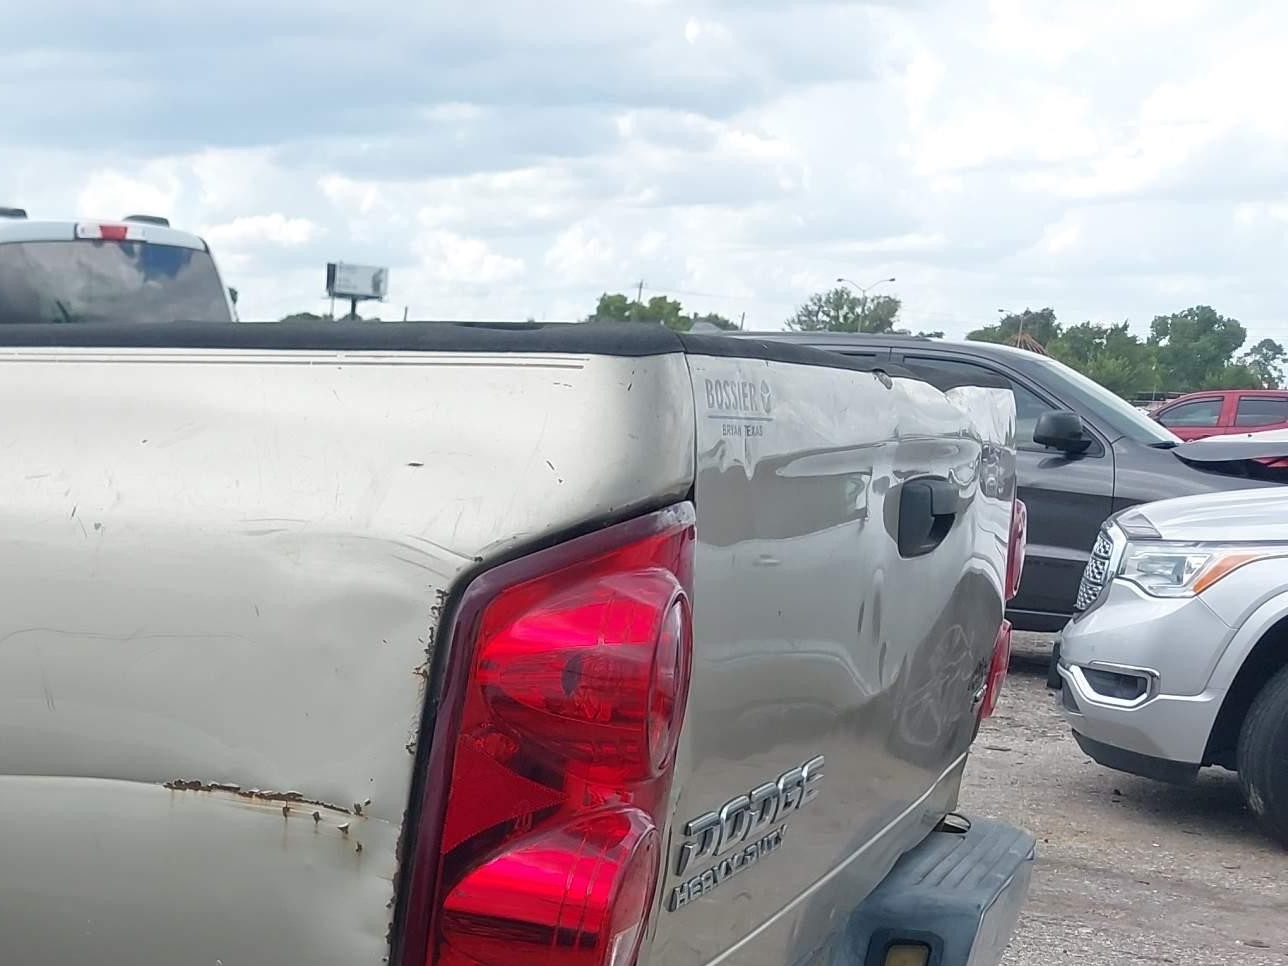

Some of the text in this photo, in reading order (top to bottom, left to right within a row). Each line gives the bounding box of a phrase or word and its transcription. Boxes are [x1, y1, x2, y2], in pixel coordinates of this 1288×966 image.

[704, 379, 758, 411] BOSSIER
[722, 424, 763, 437] BRYAN TEXAS
[675, 755, 825, 877] DODGE
